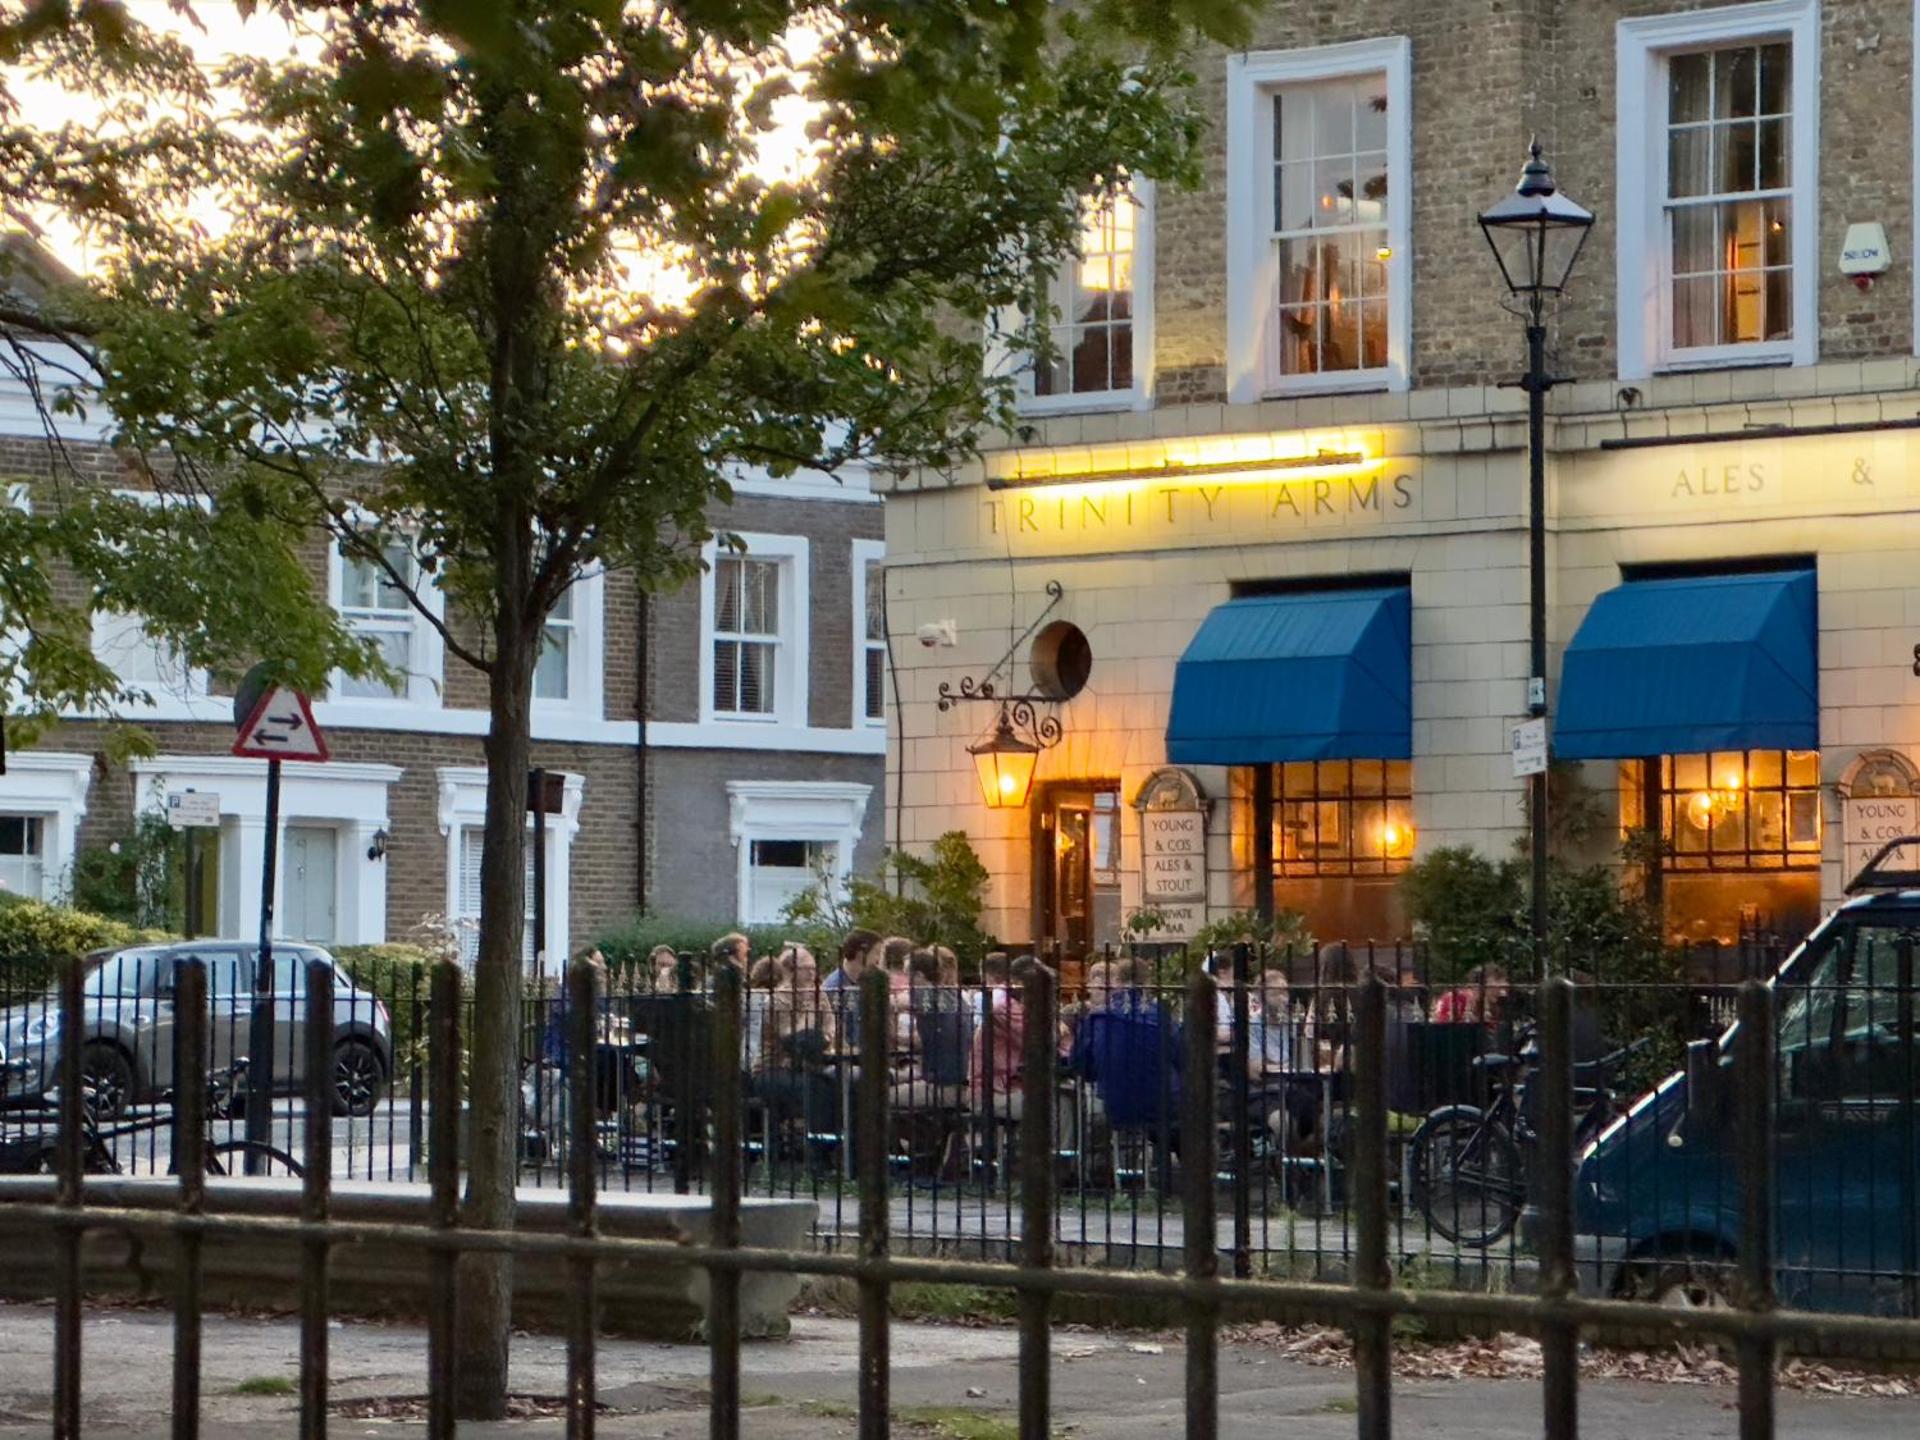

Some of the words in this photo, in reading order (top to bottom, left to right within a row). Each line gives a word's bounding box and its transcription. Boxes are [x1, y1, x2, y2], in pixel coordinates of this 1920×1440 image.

[1672, 463, 1764, 497] ALES
[1852, 456, 1874, 485] &
[984, 487, 1223, 534] TRINITY
[1272, 474, 1413, 518] ARMS
[1856, 804, 1906, 818] YOUNG
[1152, 819, 1194, 831] YOUNG
[1860, 826, 1871, 839] &
[1155, 840, 1164, 852] &
[1154, 859, 1180, 872] ALES
[1184, 858, 1192, 871] &
[1156, 879, 1192, 891] STOUT
